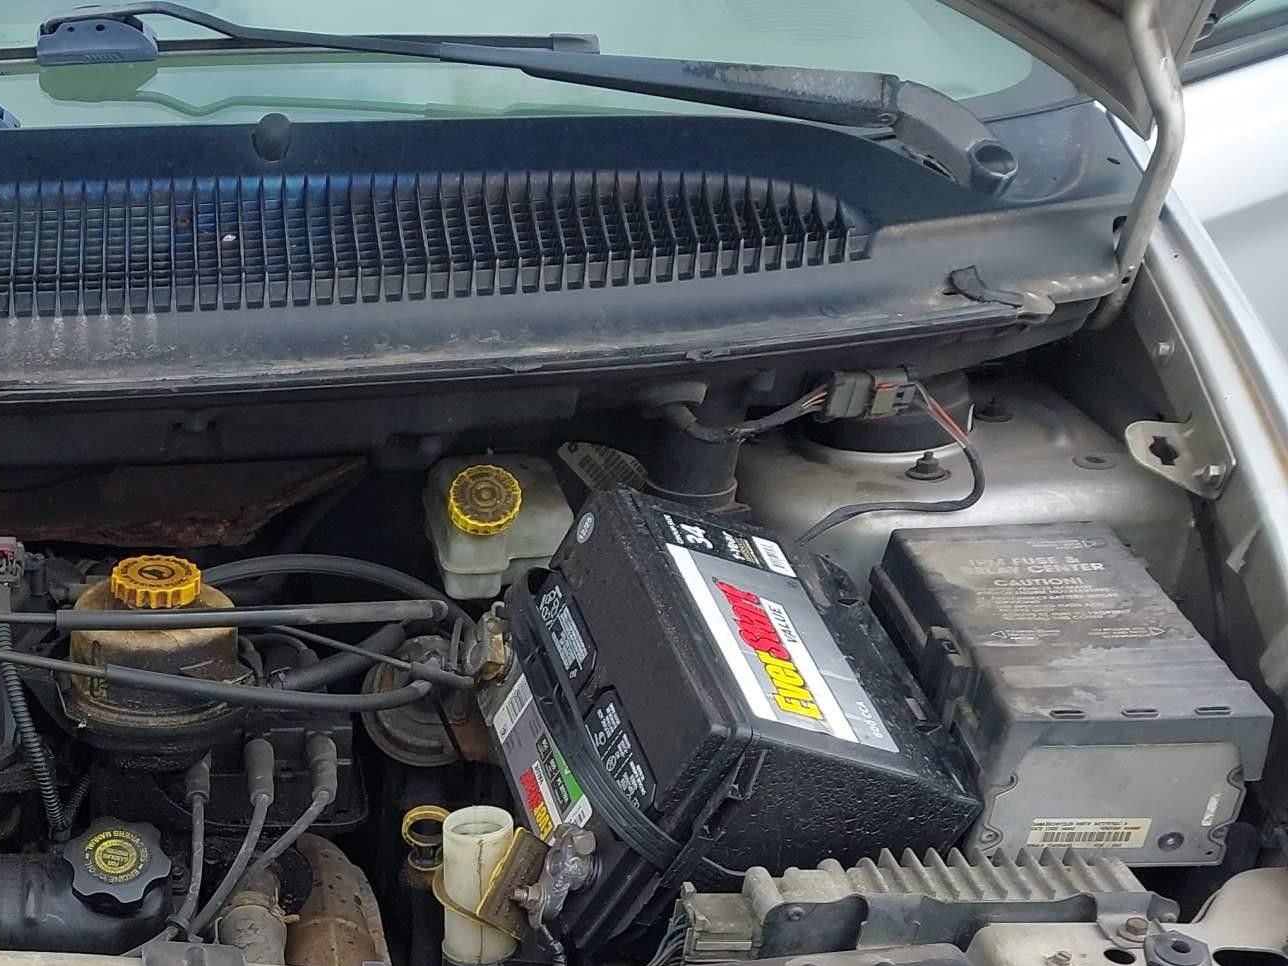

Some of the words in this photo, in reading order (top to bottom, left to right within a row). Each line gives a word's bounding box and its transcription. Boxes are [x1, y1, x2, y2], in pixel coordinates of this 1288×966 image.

[680, 523, 714, 549] 34
[960, 566, 1018, 575] RELAY
[1028, 562, 1105, 573] CENTER
[1011, 557, 1056, 566] FUSE
[1064, 556, 1081, 564] &
[994, 577, 1083, 586] CAUTION!
[768, 604, 799, 643] VALUE
[715, 580, 825, 720] EverStart
[856, 701, 872, 723] CCA
[534, 764, 544, 785] VALUE
[520, 766, 554, 841] EverStart
[85, 831, 112, 851] MANUAL
[85, 859, 96, 874] OIL
[108, 869, 140, 883] ENGINE
